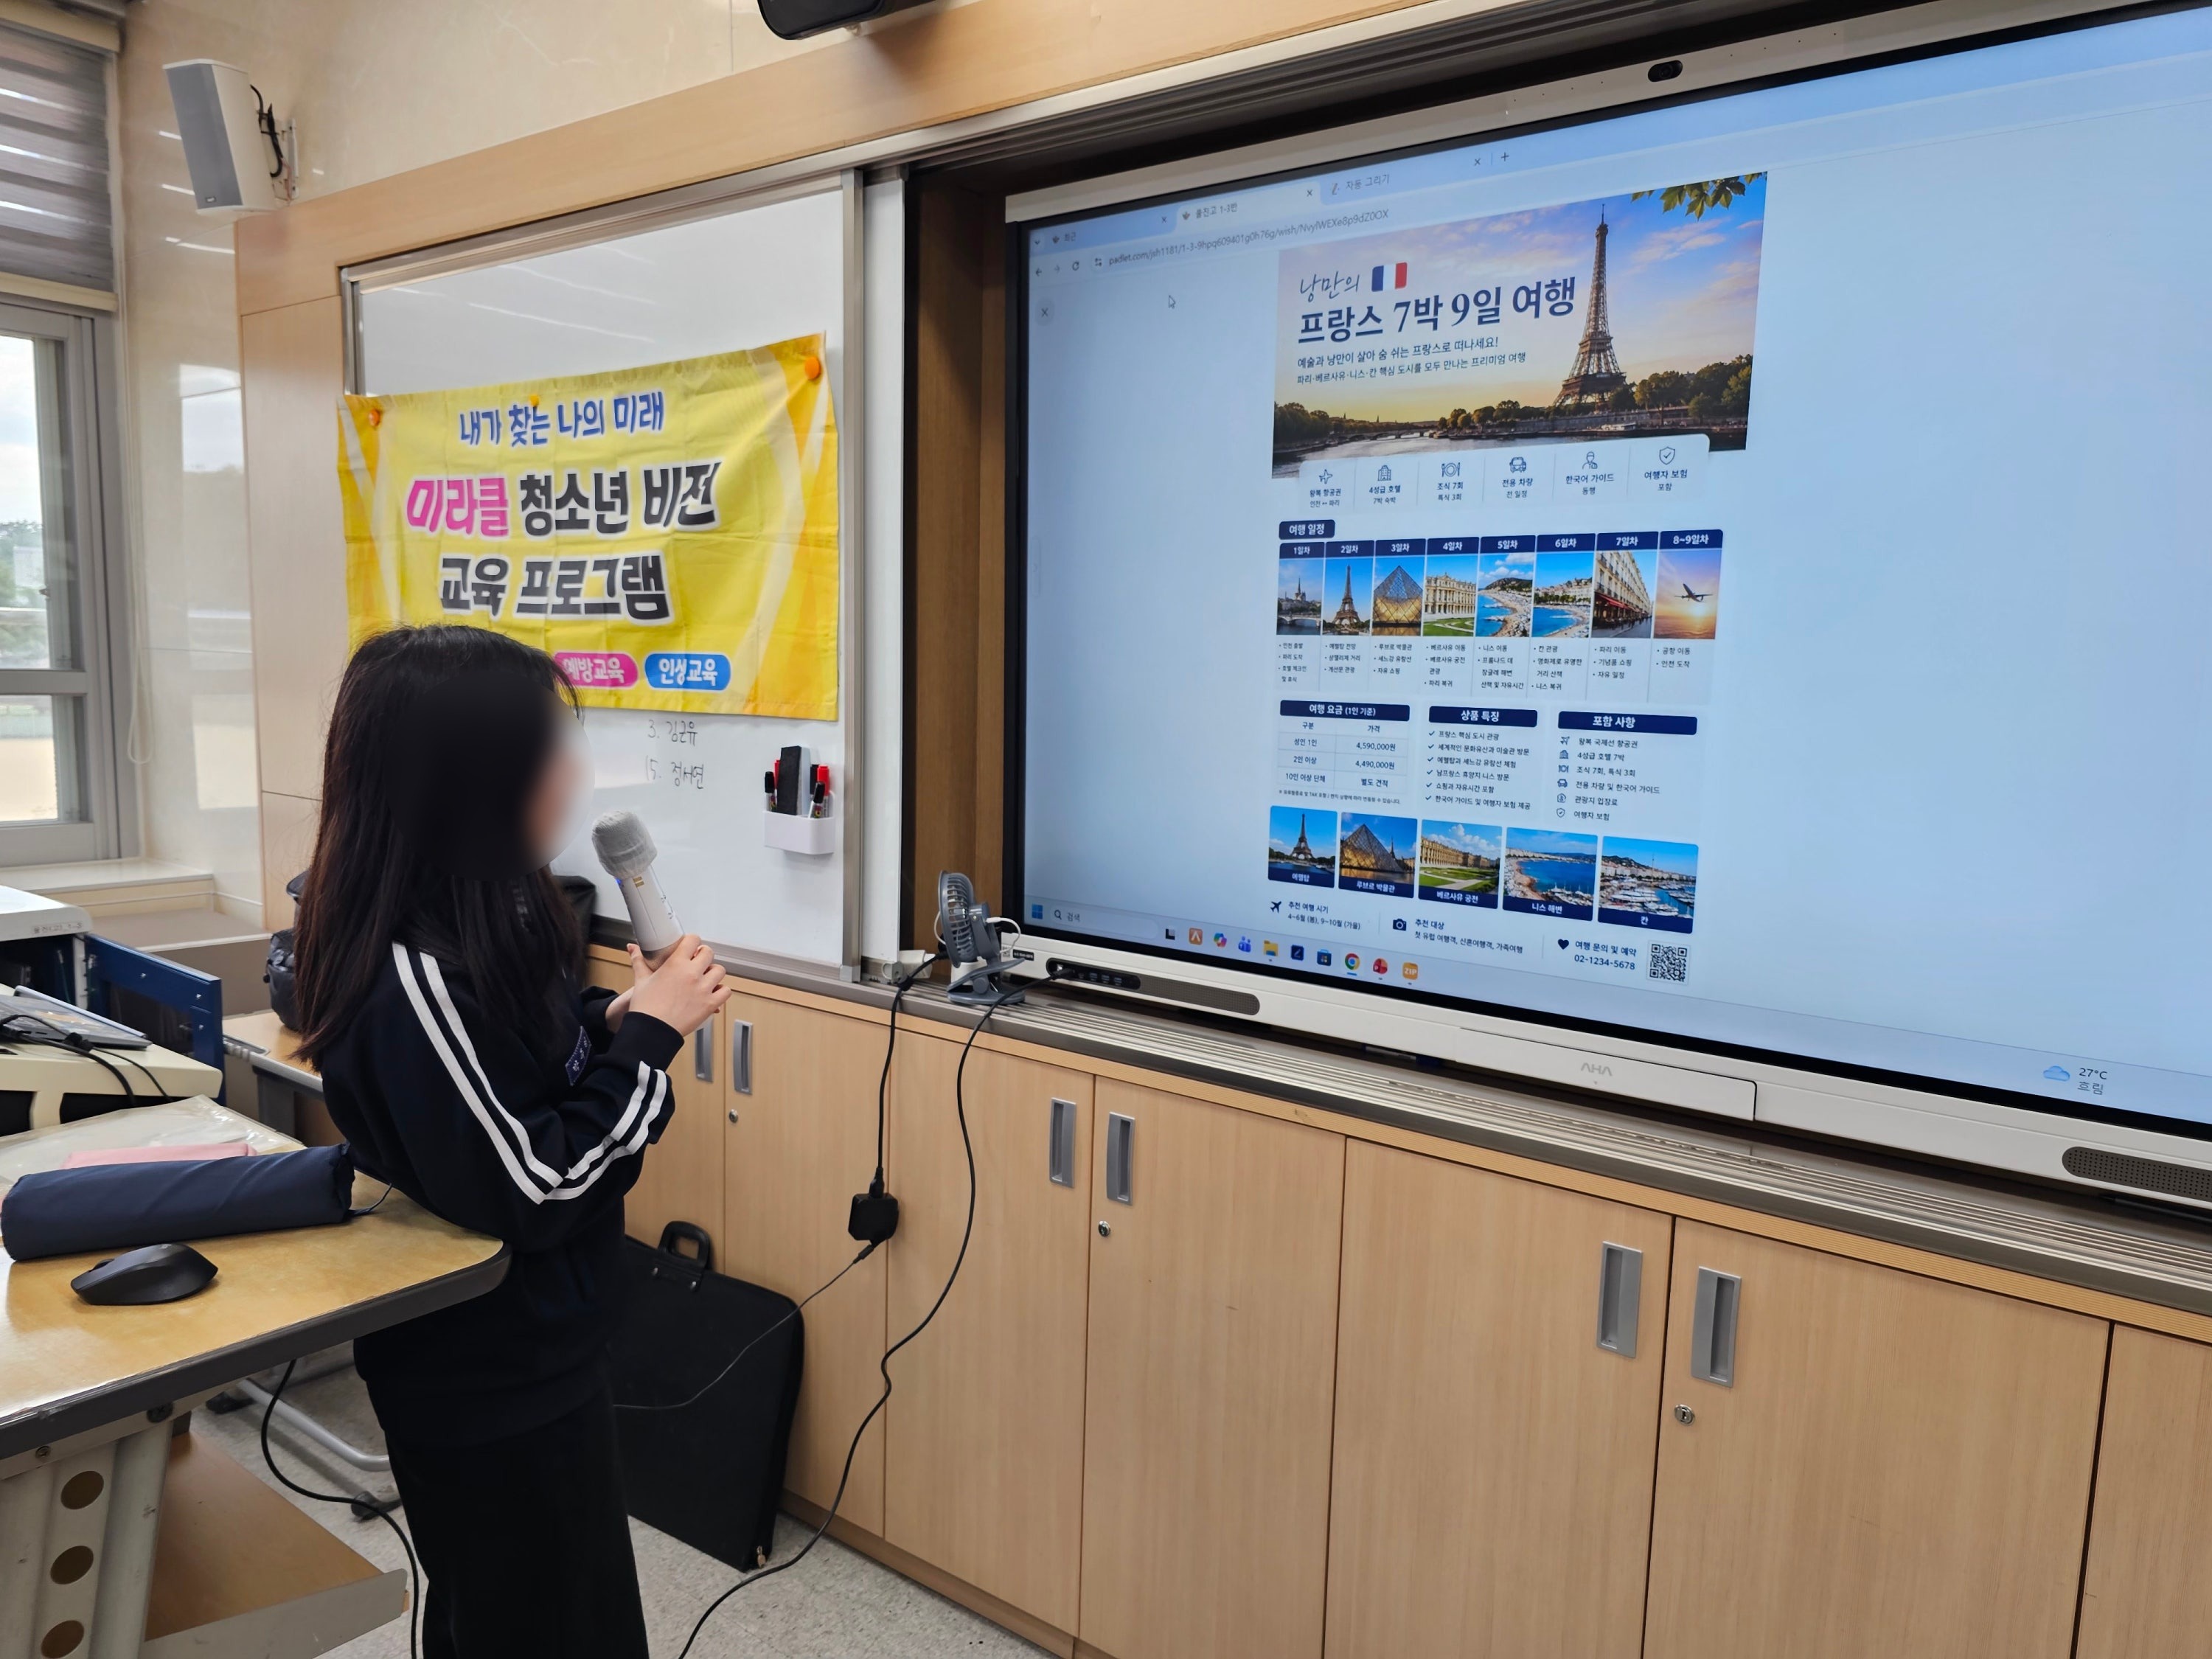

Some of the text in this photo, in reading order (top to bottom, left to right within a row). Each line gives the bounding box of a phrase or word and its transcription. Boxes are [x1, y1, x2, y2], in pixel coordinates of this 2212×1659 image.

[1346, 174, 1390, 191] 자동 그리기
[1300, 271, 1360, 303] 낭만의
[1298, 276, 1576, 344] 프랑스 7박 9일 여행
[1298, 336, 1498, 369] 예술과 낭만이 살아 숨 쉬는 프랑스로 떠나세요!
[1380, 366, 1395, 377] 핵심
[1397, 364, 1422, 375] 도시를
[1425, 361, 1441, 372] 모두
[1443, 358, 1468, 371] 만나는
[1471, 354, 1506, 367] 프리미엄
[1509, 352, 1526, 364] 여행
[460, 392, 664, 447] 내가 찾는 나의 미래
[1565, 473, 1615, 484] 한국어 가이드
[1644, 470, 1688, 480] 여행자 보험
[1436, 481, 1464, 490] 조식 7회
[1518, 478, 1533, 487] 차량
[1369, 485, 1385, 494] 4성급
[407, 462, 723, 536] 미라클 청소년 비전
[1289, 524, 1325, 535] 여행 일정
[1498, 540, 1517, 549] 5일차
[1555, 538, 1576, 548] 6일차
[1616, 536, 1638, 546] 7일차
[1673, 535, 1709, 545] 8~9일차
[1293, 547, 1310, 555] 1일차
[1340, 545, 1359, 554] 2일차
[1391, 543, 1410, 553] 3일차
[1443, 542, 1463, 551] 4일차
[441, 554, 669, 619] 교육 프로그램
[562, 657, 625, 684] 예방교육
[658, 658, 718, 686] 인생교육
[1310, 703, 1376, 717] 여행 요금 (1인 기준)
[1461, 710, 1500, 723] 상품 특징
[1593, 716, 1635, 728] 포함 사항
[1367, 725, 1380, 733] 가격
[1439, 730, 1456, 738] 프랑스
[1472, 731, 1485, 740] 도시
[1294, 738, 1305, 746] 성인
[1356, 742, 1396, 751] 4,590,000원
[1293, 756, 1317, 765] 2인 이상
[1355, 760, 1395, 770] 4,490,000원
[1286, 773, 1298, 781] 10인
[1300, 773, 1312, 782] 이상
[1435, 795, 1453, 803] 한국어
[1455, 796, 1473, 805] 가이드
[1573, 811, 1594, 819] 여행자
[1302, 903, 1315, 912] 여행
[1316, 905, 1329, 914] 시기
[1531, 902, 1546, 912] 니스
[1415, 919, 1444, 930] 추천 대상
[1575, 941, 1637, 957] 여행 문의 및 예약
[1574, 954, 1635, 970] 02-1234-5678
[2079, 1067, 2108, 1080] 27°C
[2077, 1081, 2104, 1096] 흐림
